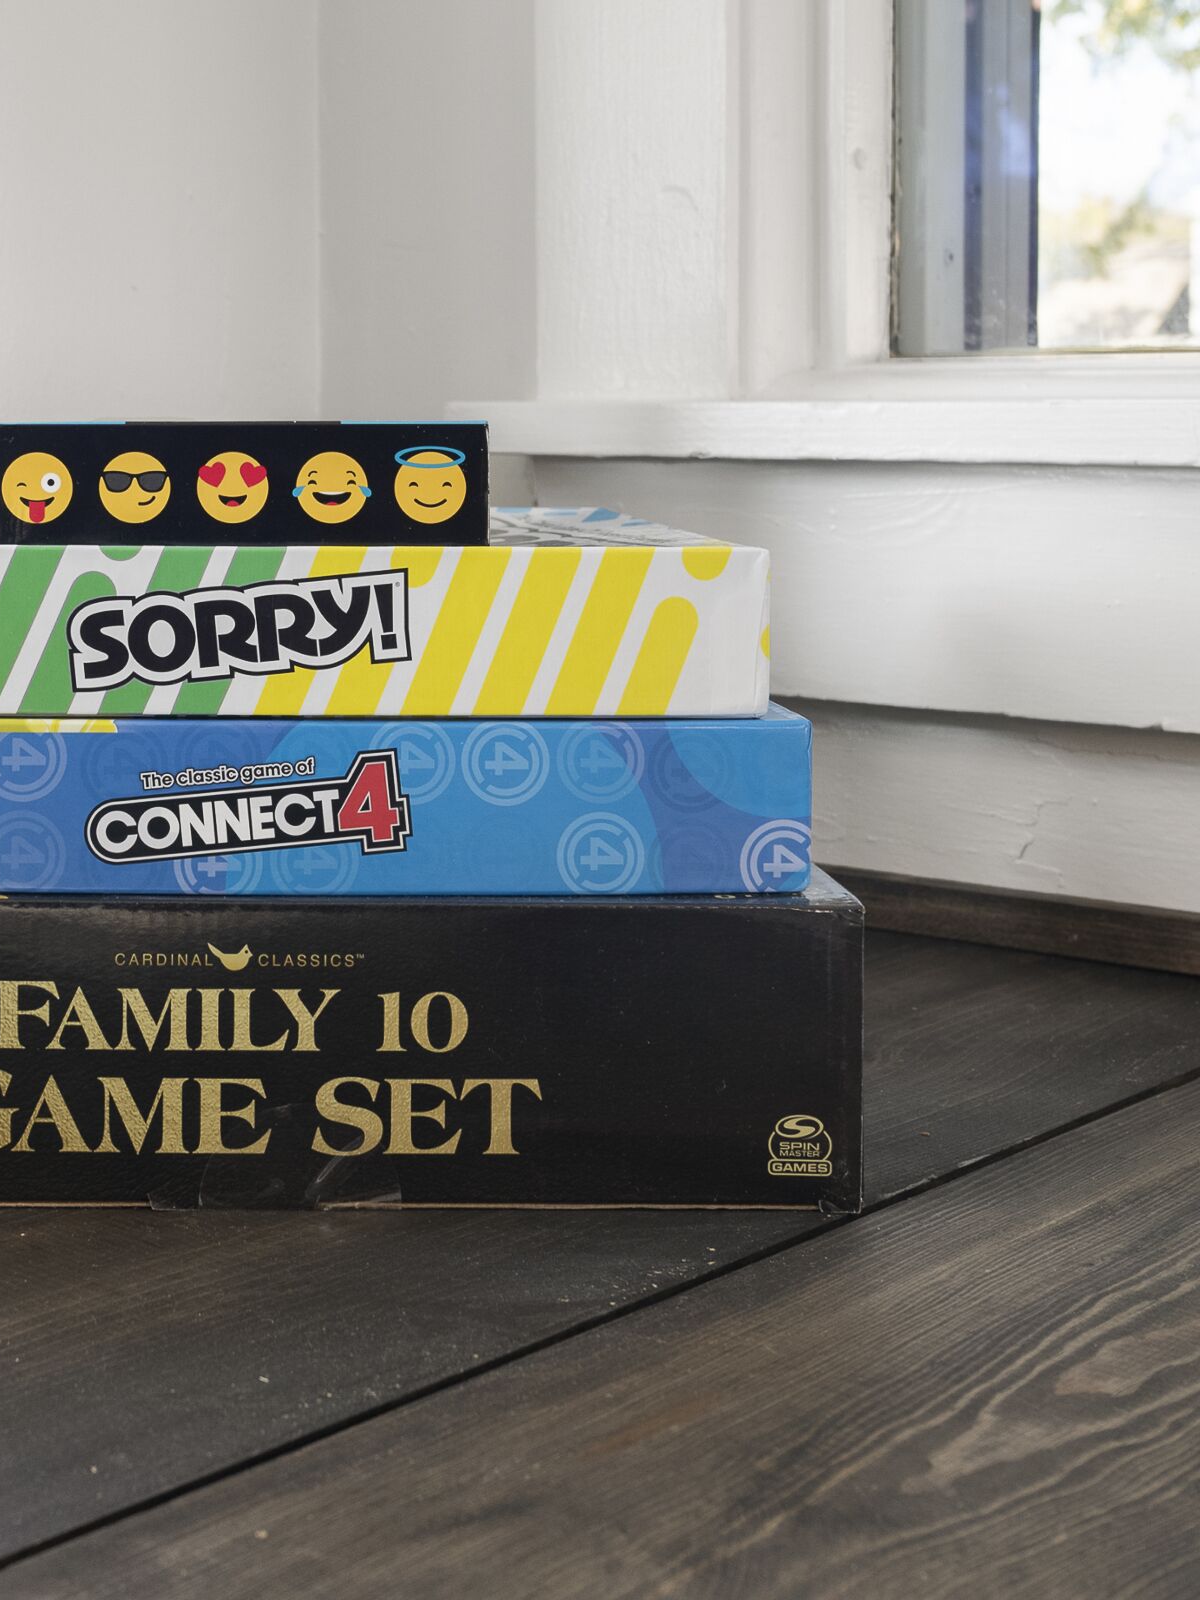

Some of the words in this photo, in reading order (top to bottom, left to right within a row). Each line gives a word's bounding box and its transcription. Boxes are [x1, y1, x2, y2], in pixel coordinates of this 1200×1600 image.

[75, 579, 402, 683] SORRY!
[141, 773, 174, 789] The
[176, 766, 238, 785] classic
[240, 762, 293, 784] game
[295, 757, 315, 776] of
[114, 953, 213, 967] CARDINAL
[376, 991, 469, 1052] 10
[311, 1076, 543, 1155] SET
[779, 1142, 820, 1151] SPIN
[779, 1150, 820, 1158] MASTER
[772, 1163, 828, 1173] GAMES
